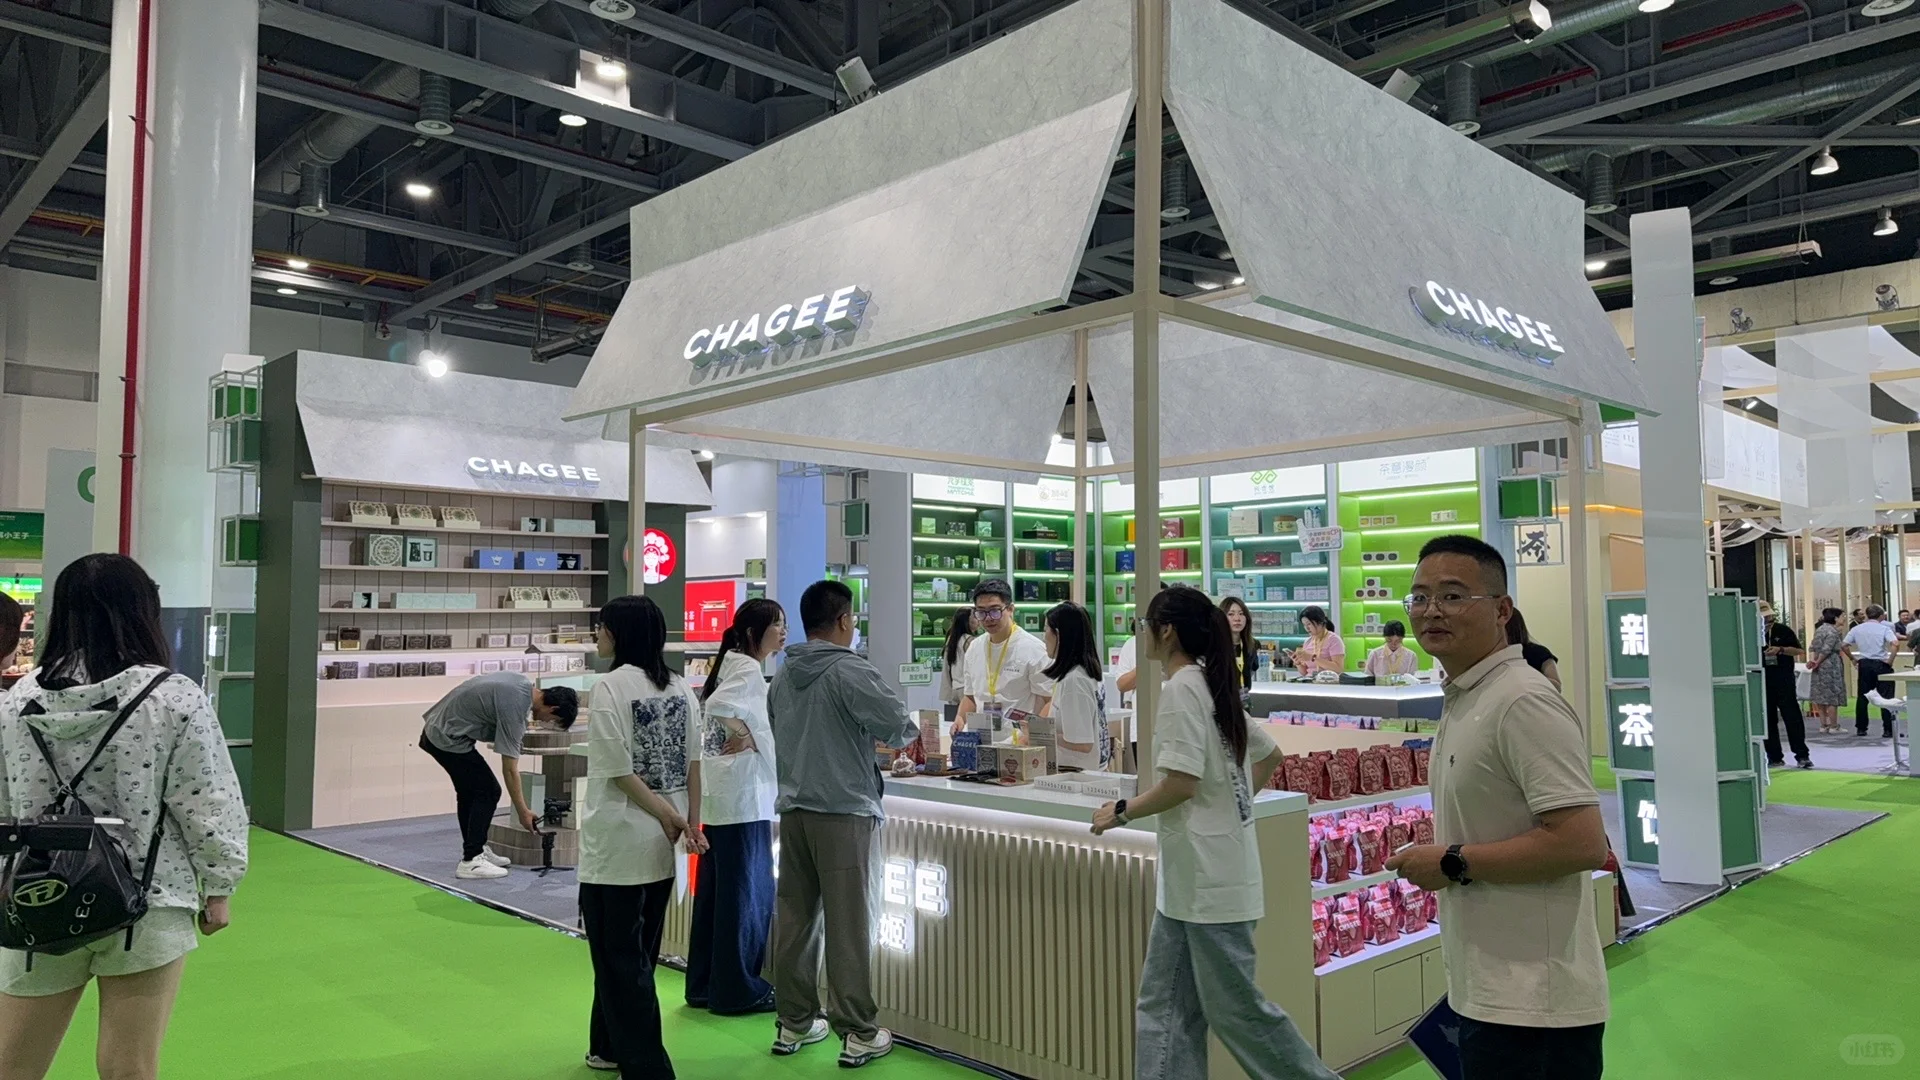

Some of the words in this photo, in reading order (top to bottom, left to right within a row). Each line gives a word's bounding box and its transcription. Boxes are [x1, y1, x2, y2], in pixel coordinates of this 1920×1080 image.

[683, 284, 858, 361] CHAGEE
[1426, 280, 1565, 353] CHAGEE
[467, 456, 601, 482] CHAGEE
[641, 735, 686, 750] CHAGEE
[952, 739, 977, 748] CHAGEE
[884, 863, 941, 913] EE
[879, 913, 906, 950] 姬
